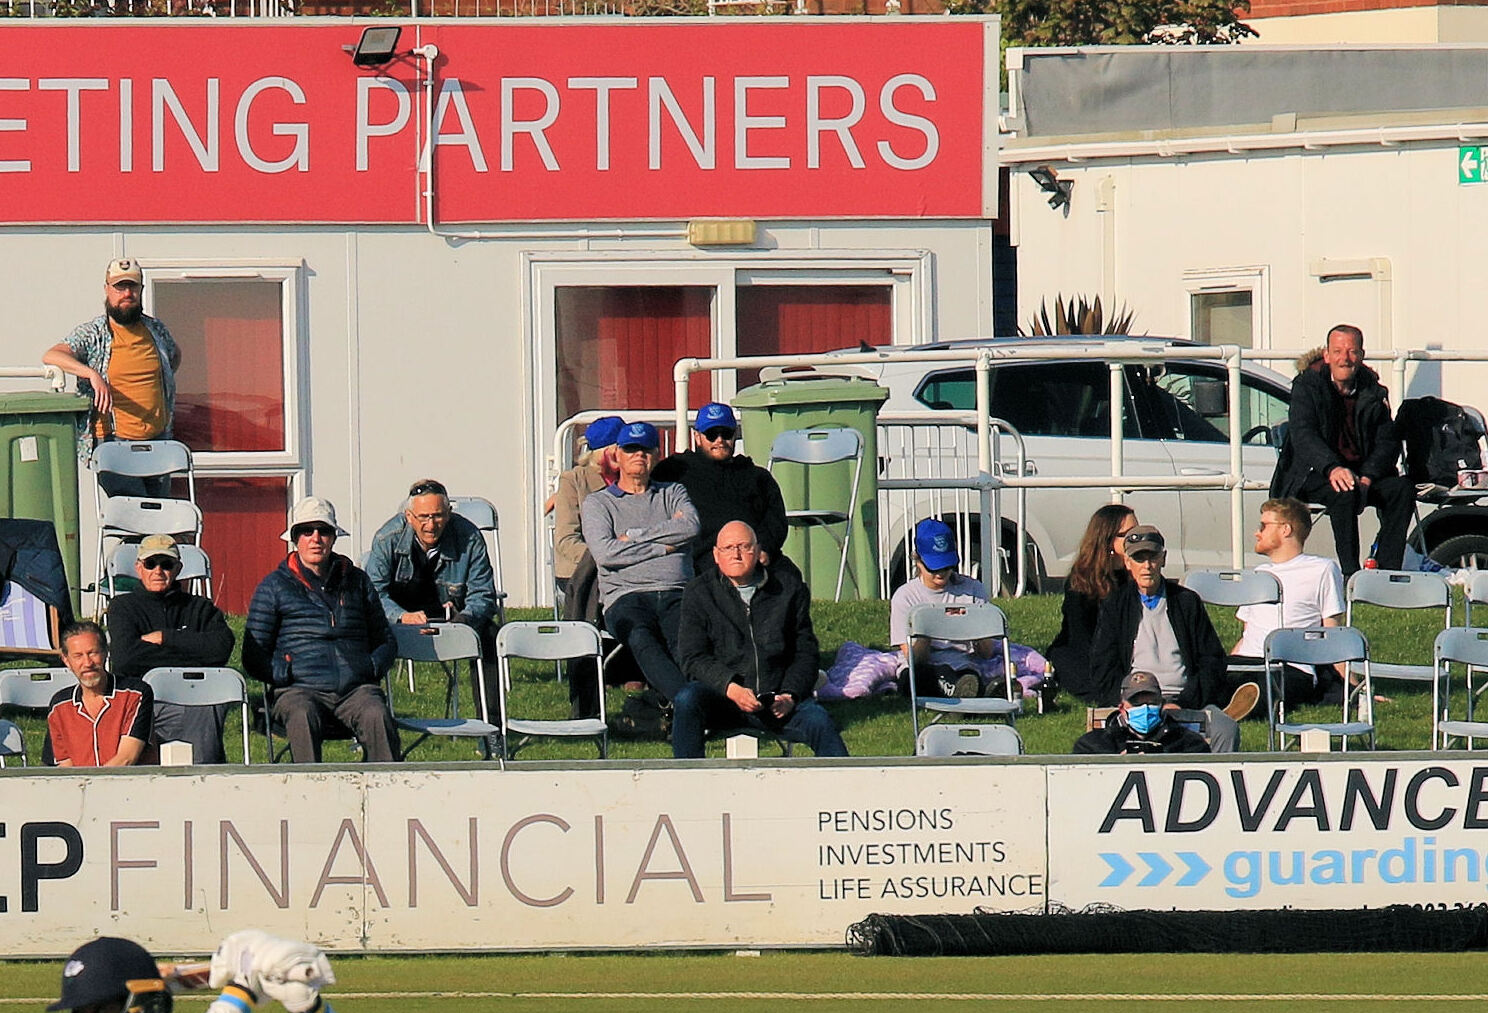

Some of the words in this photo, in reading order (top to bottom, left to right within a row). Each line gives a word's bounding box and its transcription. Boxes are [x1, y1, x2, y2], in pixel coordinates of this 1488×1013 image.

[356, 73, 940, 171] PARTNERS
[818, 808, 954, 833] PENSIONS
[110, 813, 773, 911] FINANCIAL
[819, 841, 1007, 867] INVESTMENTS
[1223, 837, 1488, 899] guardin
[819, 878, 872, 900] LIFE
[880, 874, 1043, 899] ASSURANCE
